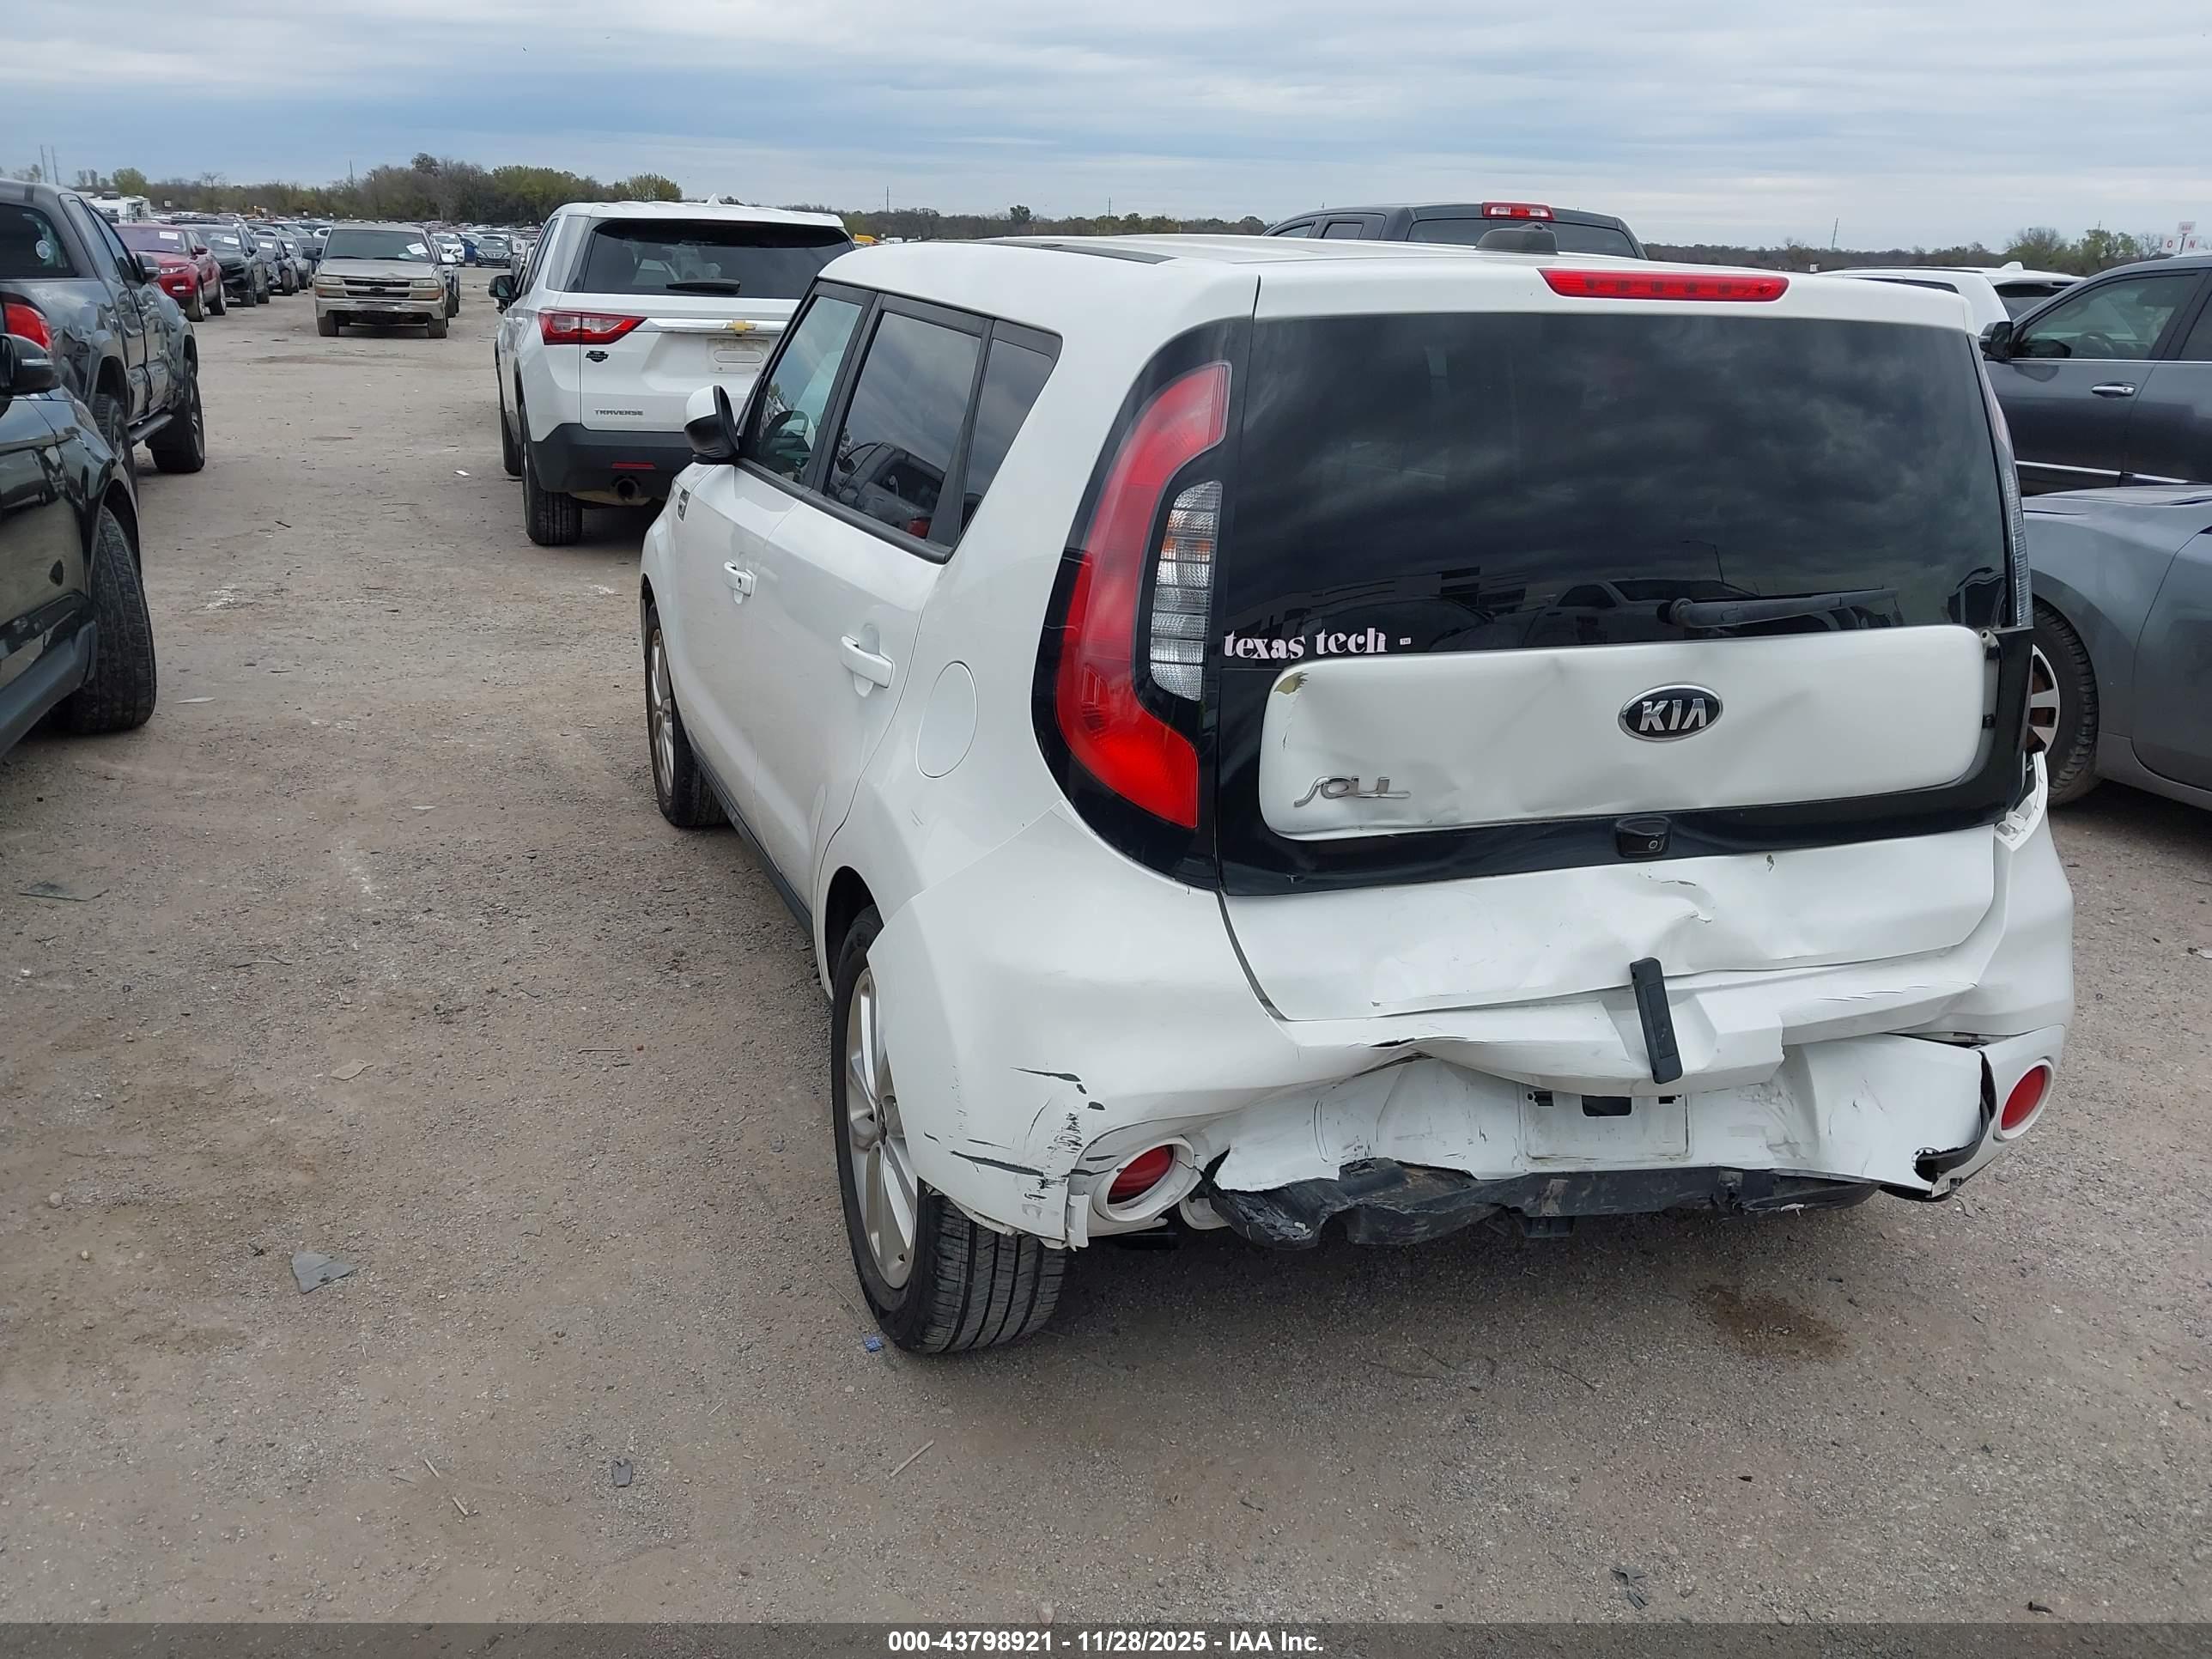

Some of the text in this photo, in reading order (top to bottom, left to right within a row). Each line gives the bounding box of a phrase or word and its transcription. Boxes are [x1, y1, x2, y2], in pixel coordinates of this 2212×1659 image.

[1224, 630, 1306, 659] texas
[1316, 627, 1389, 655] tech
[1638, 697, 1707, 732] KIA
